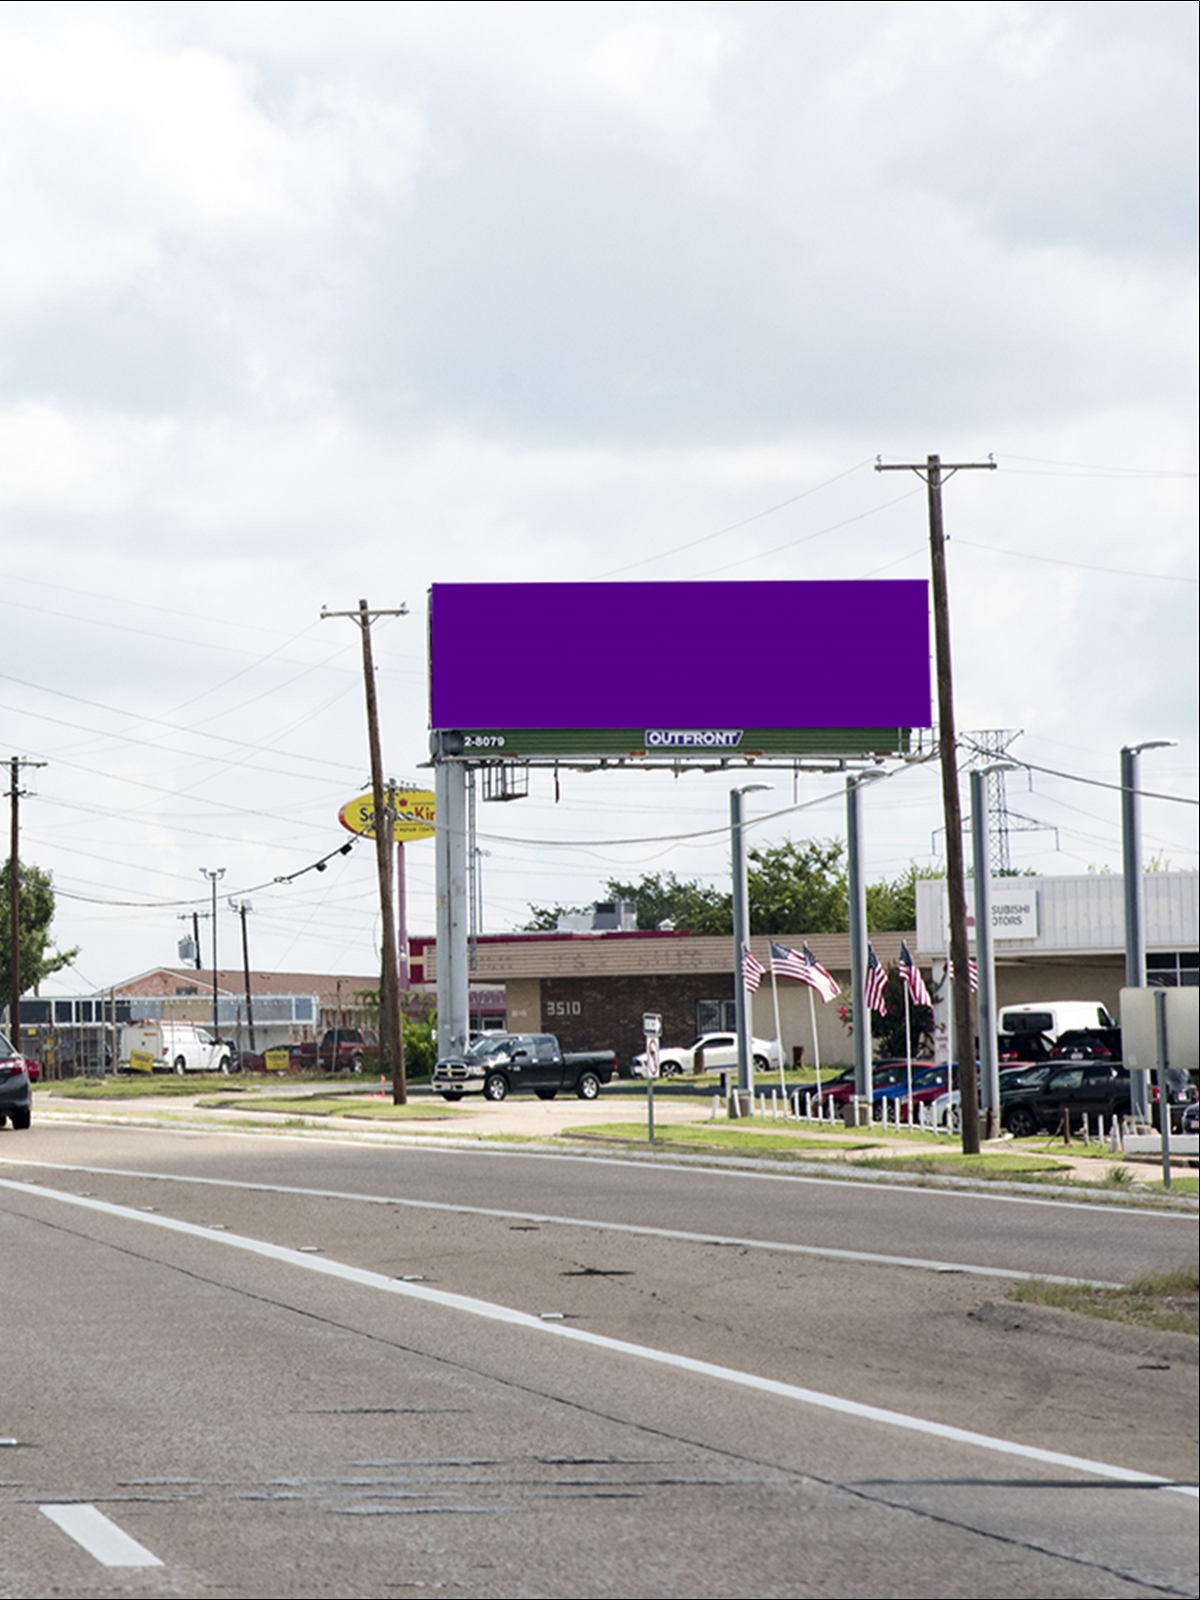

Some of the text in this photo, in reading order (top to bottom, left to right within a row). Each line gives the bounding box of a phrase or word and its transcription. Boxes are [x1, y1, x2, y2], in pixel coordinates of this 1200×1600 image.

[464, 735, 505, 747] 2-8079
[649, 731, 737, 745] OUTFRONT
[991, 904, 1030, 915] SUBISHI
[992, 916, 1023, 927] OTORS
[547, 1001, 581, 1016] 3510
